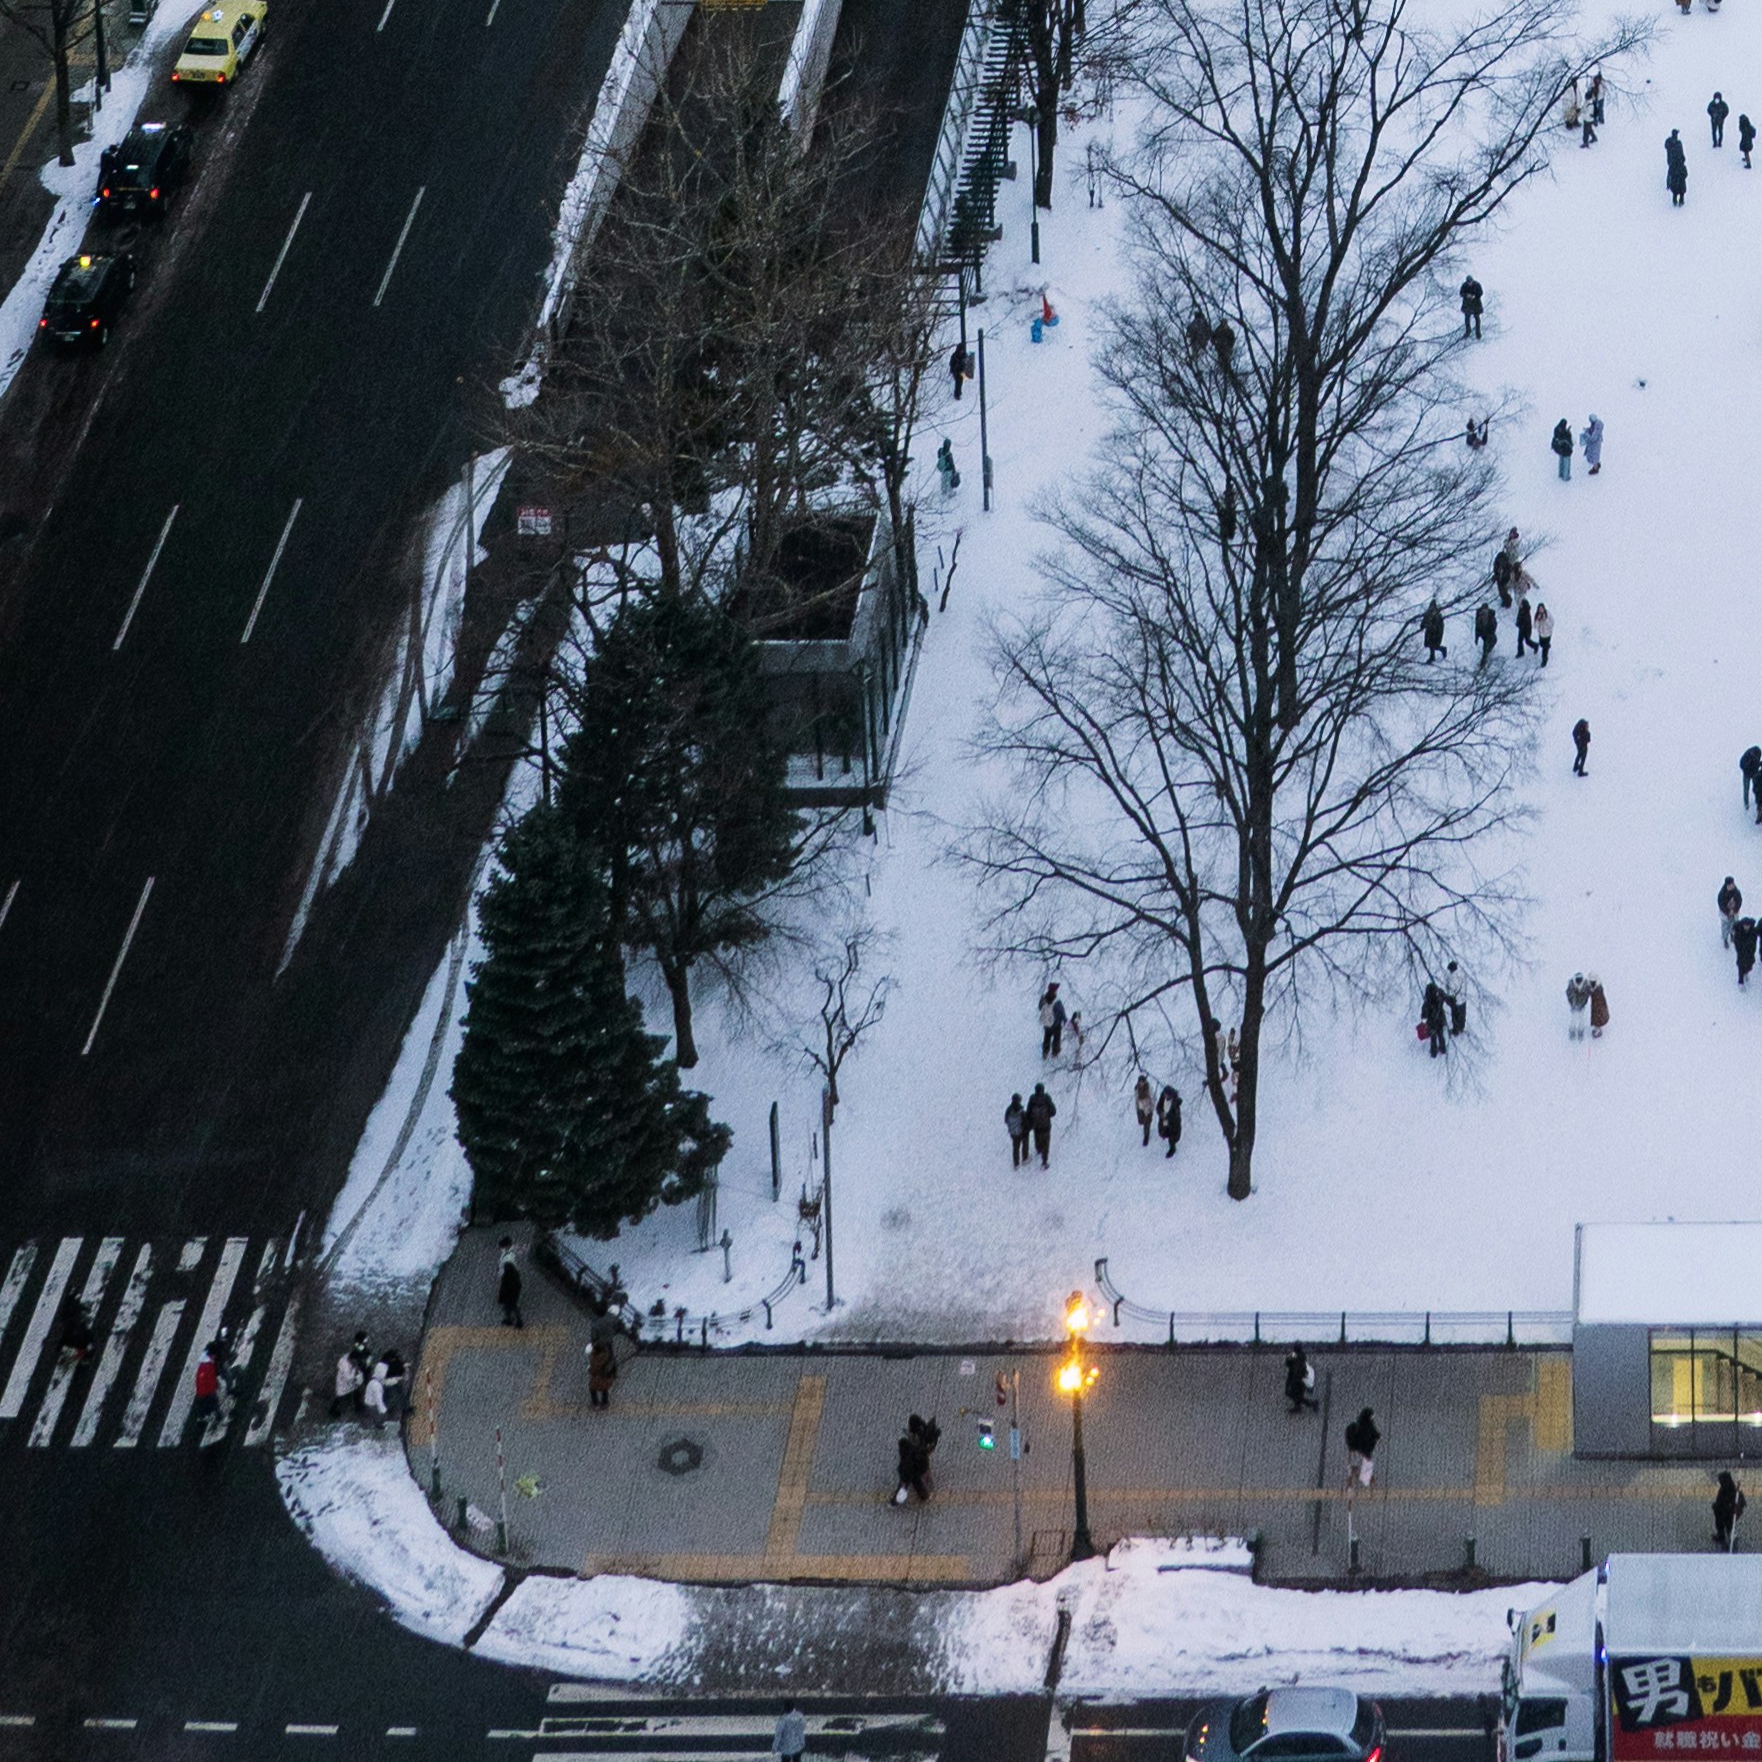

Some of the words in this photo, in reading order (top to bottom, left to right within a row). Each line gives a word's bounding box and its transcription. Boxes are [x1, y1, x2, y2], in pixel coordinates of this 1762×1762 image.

[1654, 1730, 1762, 1750] 就職祝い金
